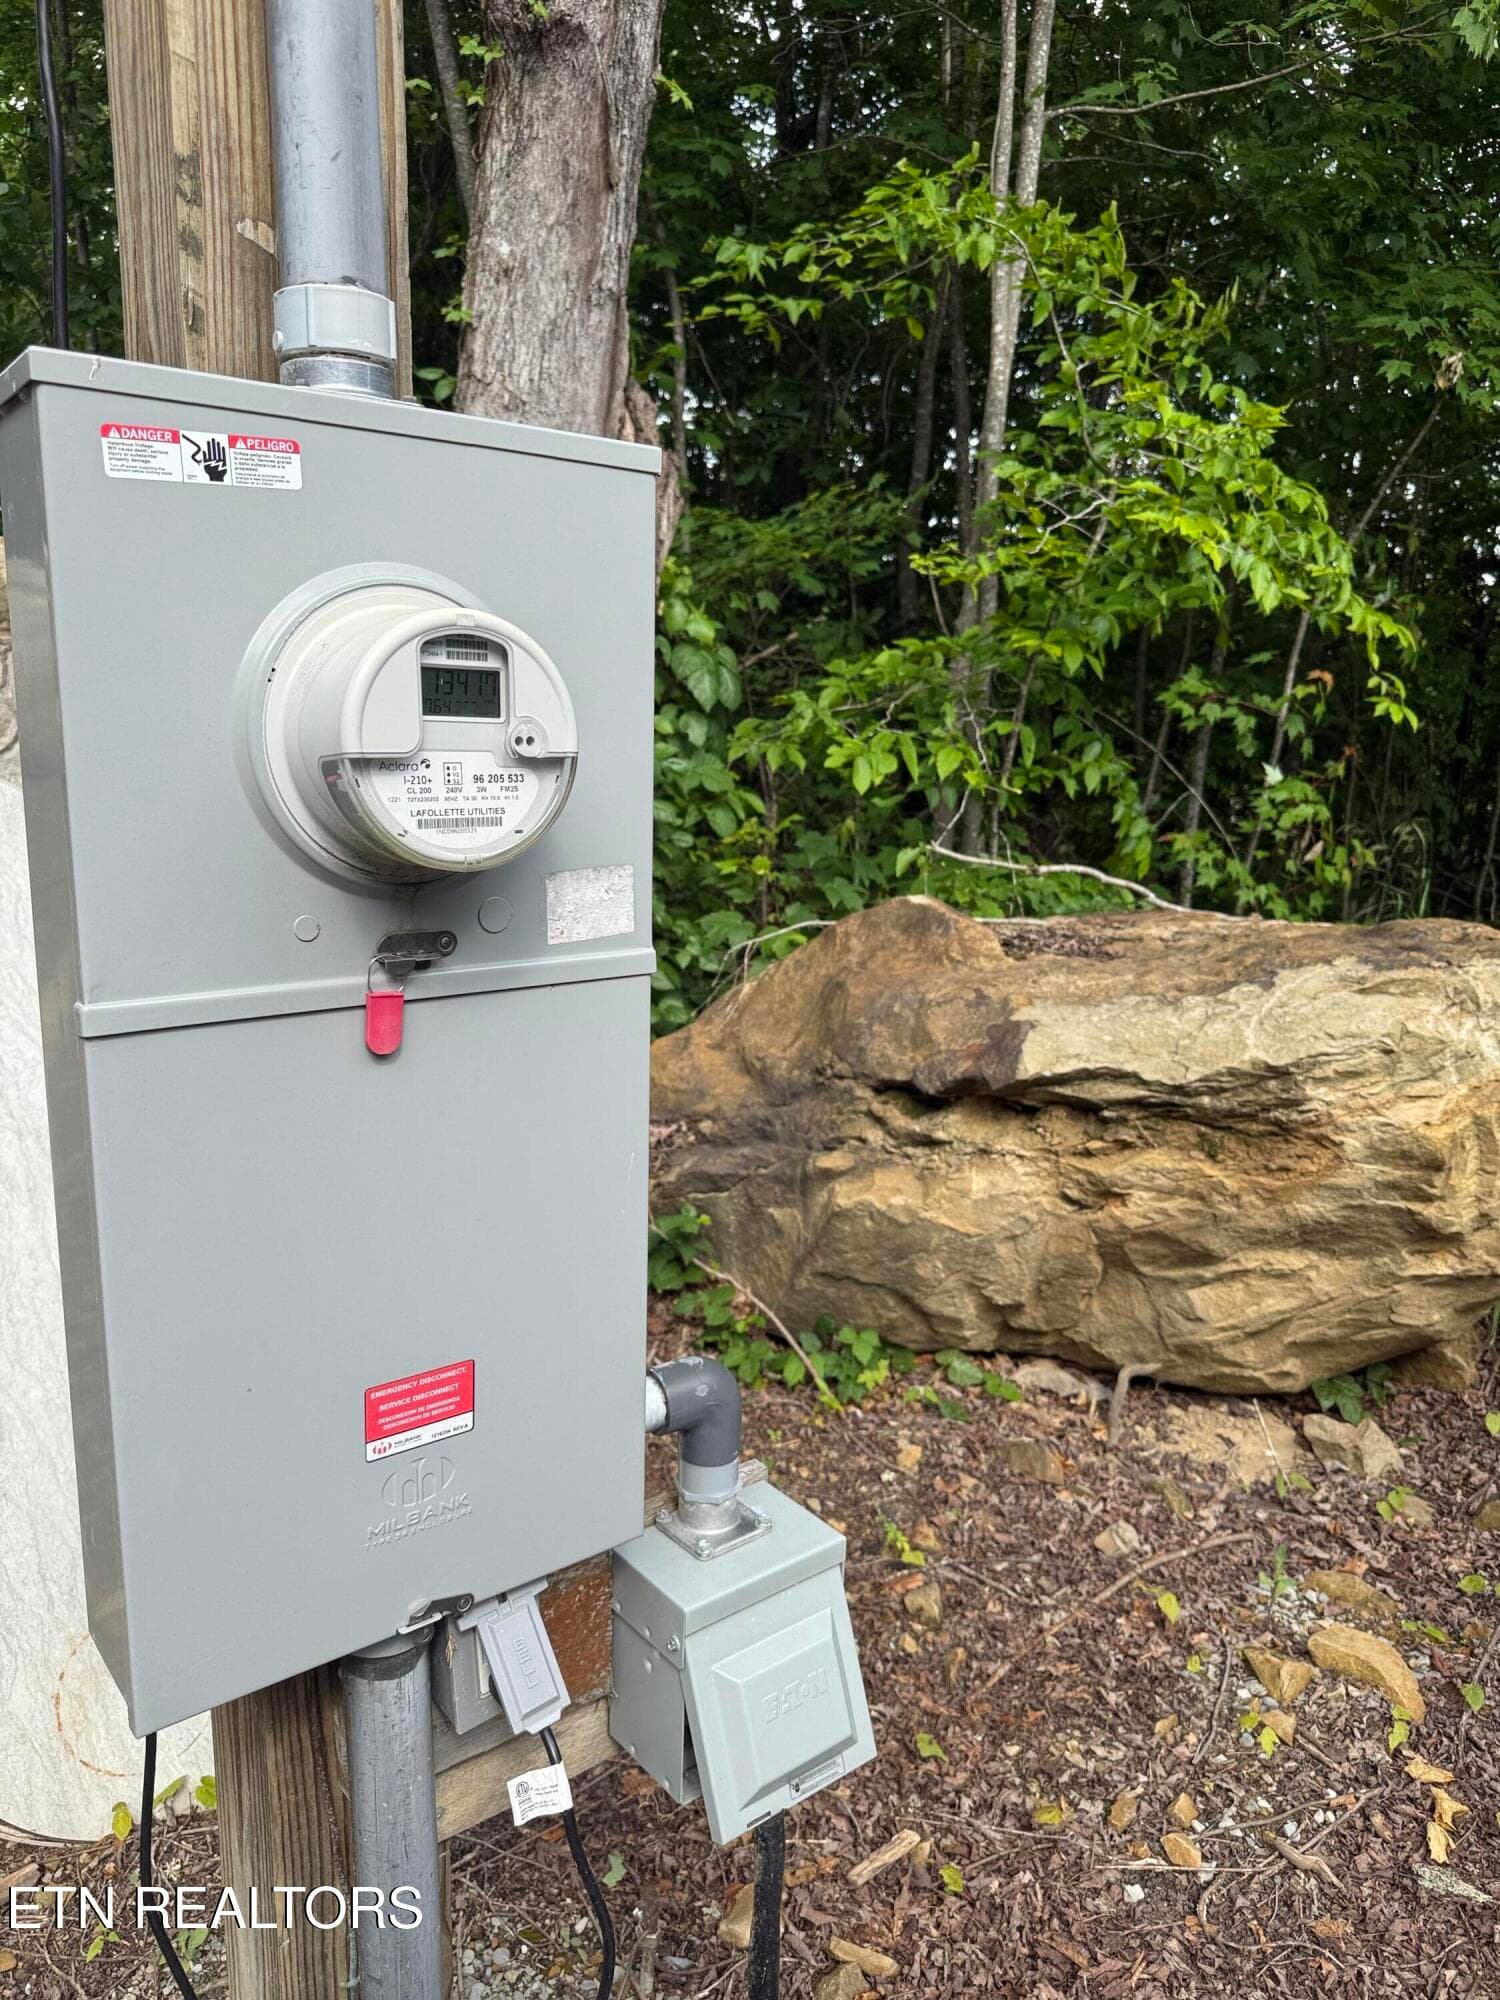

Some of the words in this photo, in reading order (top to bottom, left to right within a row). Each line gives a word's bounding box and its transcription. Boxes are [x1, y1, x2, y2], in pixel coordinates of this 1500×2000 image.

[120, 427, 172, 442] DANGER
[246, 438, 294, 452] PELIGRO
[378, 760, 419, 771] Aclara
[404, 775, 432, 784] I-210+
[473, 774, 484, 783] 96
[488, 774, 504, 783] 205
[508, 774, 524, 783] 533
[410, 808, 465, 817] LAFOLLETTE
[370, 1380, 418, 1400] EMERGENCY
[379, 1396, 412, 1411] SERVICE
[413, 1383, 460, 1401] DISCONNECT
[368, 1492, 469, 1540] MILBANK
